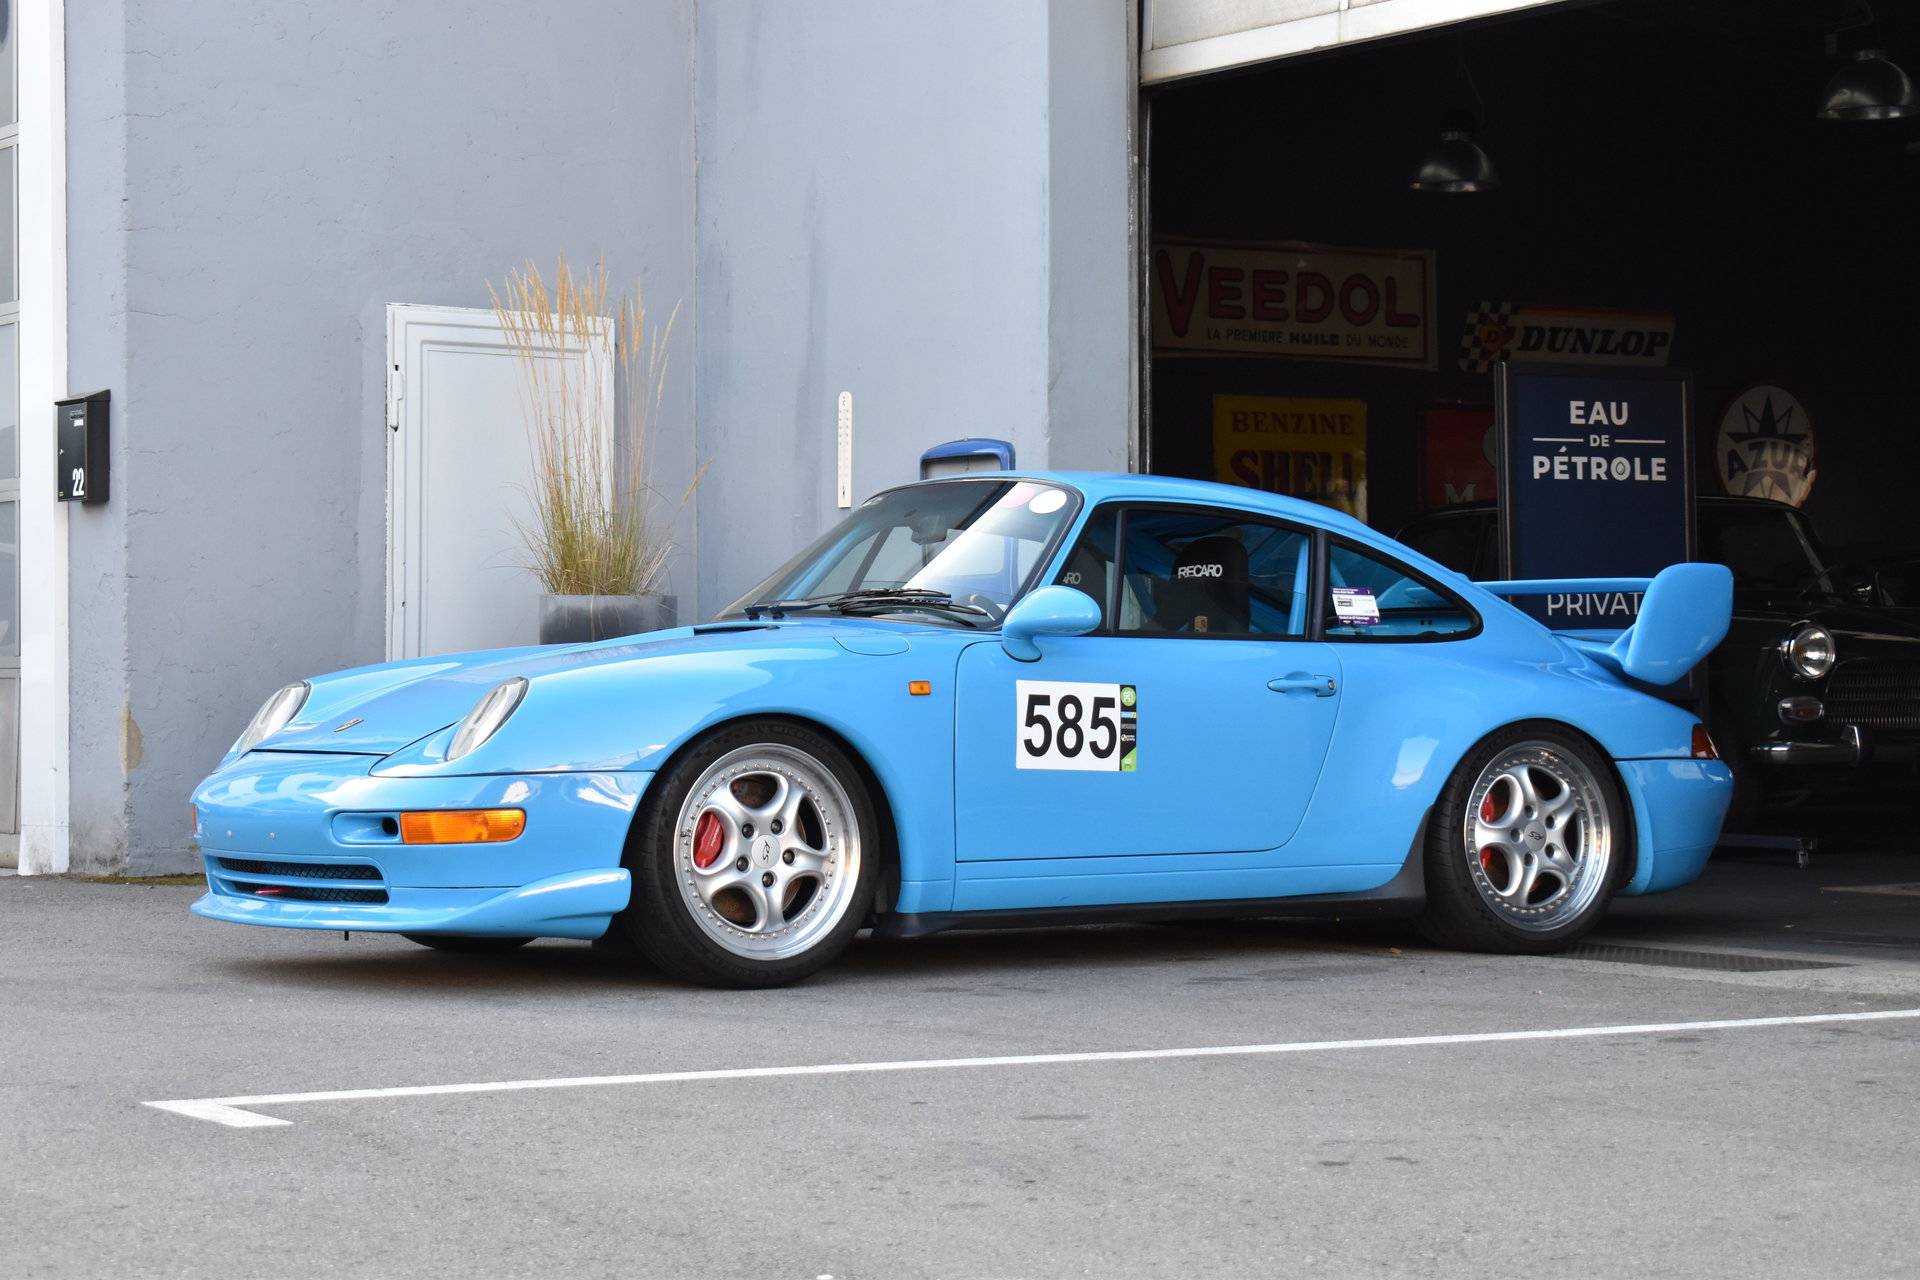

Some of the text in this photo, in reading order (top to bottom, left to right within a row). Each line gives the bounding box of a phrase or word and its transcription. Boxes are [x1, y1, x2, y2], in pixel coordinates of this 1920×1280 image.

[1155, 249, 1421, 338] VEEDOL
[1207, 328, 1221, 340] LA
[1289, 332, 1339, 346] HUILE
[1346, 334, 1362, 347] DU
[1368, 335, 1409, 349] MONDE
[1518, 325, 1670, 357] DUNLOP
[1231, 410, 1353, 435] BENZINE
[1569, 400, 1630, 426] EAU
[1589, 434, 1610, 448] DE
[1230, 450, 1356, 501] SHELL
[1532, 445, 1668, 481] PÉTROLE
[1727, 440, 1809, 481] AZUR
[72, 467, 85, 497] 22
[1178, 563, 1223, 580] RECARO
[1547, 592, 1642, 616] PRIVAT
[1024, 694, 1117, 760] 585
